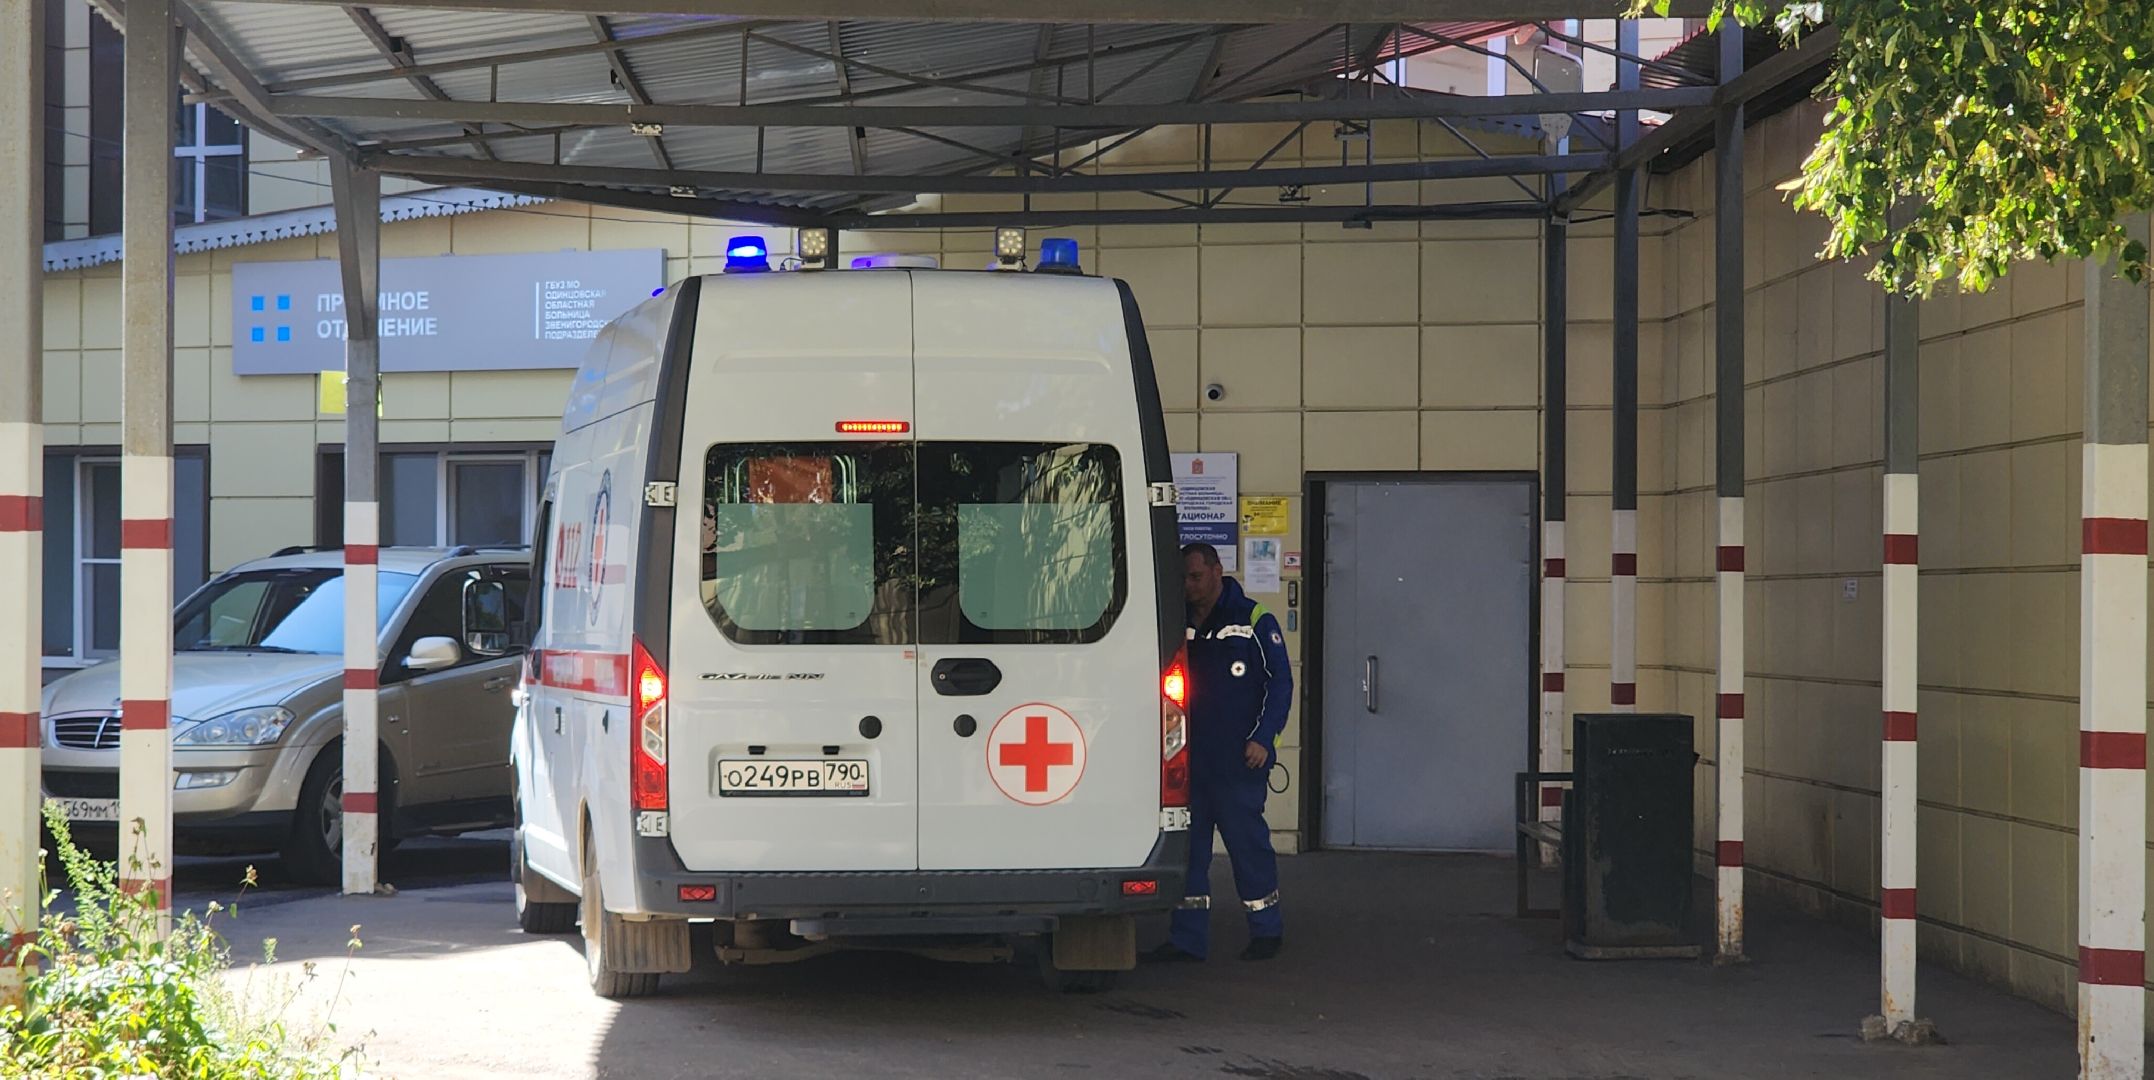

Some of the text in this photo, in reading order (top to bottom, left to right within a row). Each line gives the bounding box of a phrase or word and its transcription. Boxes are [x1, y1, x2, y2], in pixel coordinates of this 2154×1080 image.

[566, 280, 580, 289] МО
[545, 289, 608, 300] ОДИНЦОВСКАЯ
[316, 291, 430, 313] ПРНОЕ
[545, 300, 595, 310] ОБЛАСТНАЯ
[545, 310, 591, 320] БОЛЬНИЦА
[316, 317, 438, 341] ОТЕНИЕ
[545, 320, 608, 330] ЗВЕНИГОРОДС
[1177, 512, 1225, 521] ТАЦИОНАР
[563, 522, 582, 589] 112
[727, 762, 861, 788] О249РВ 790
[834, 781, 852, 789] RUS
